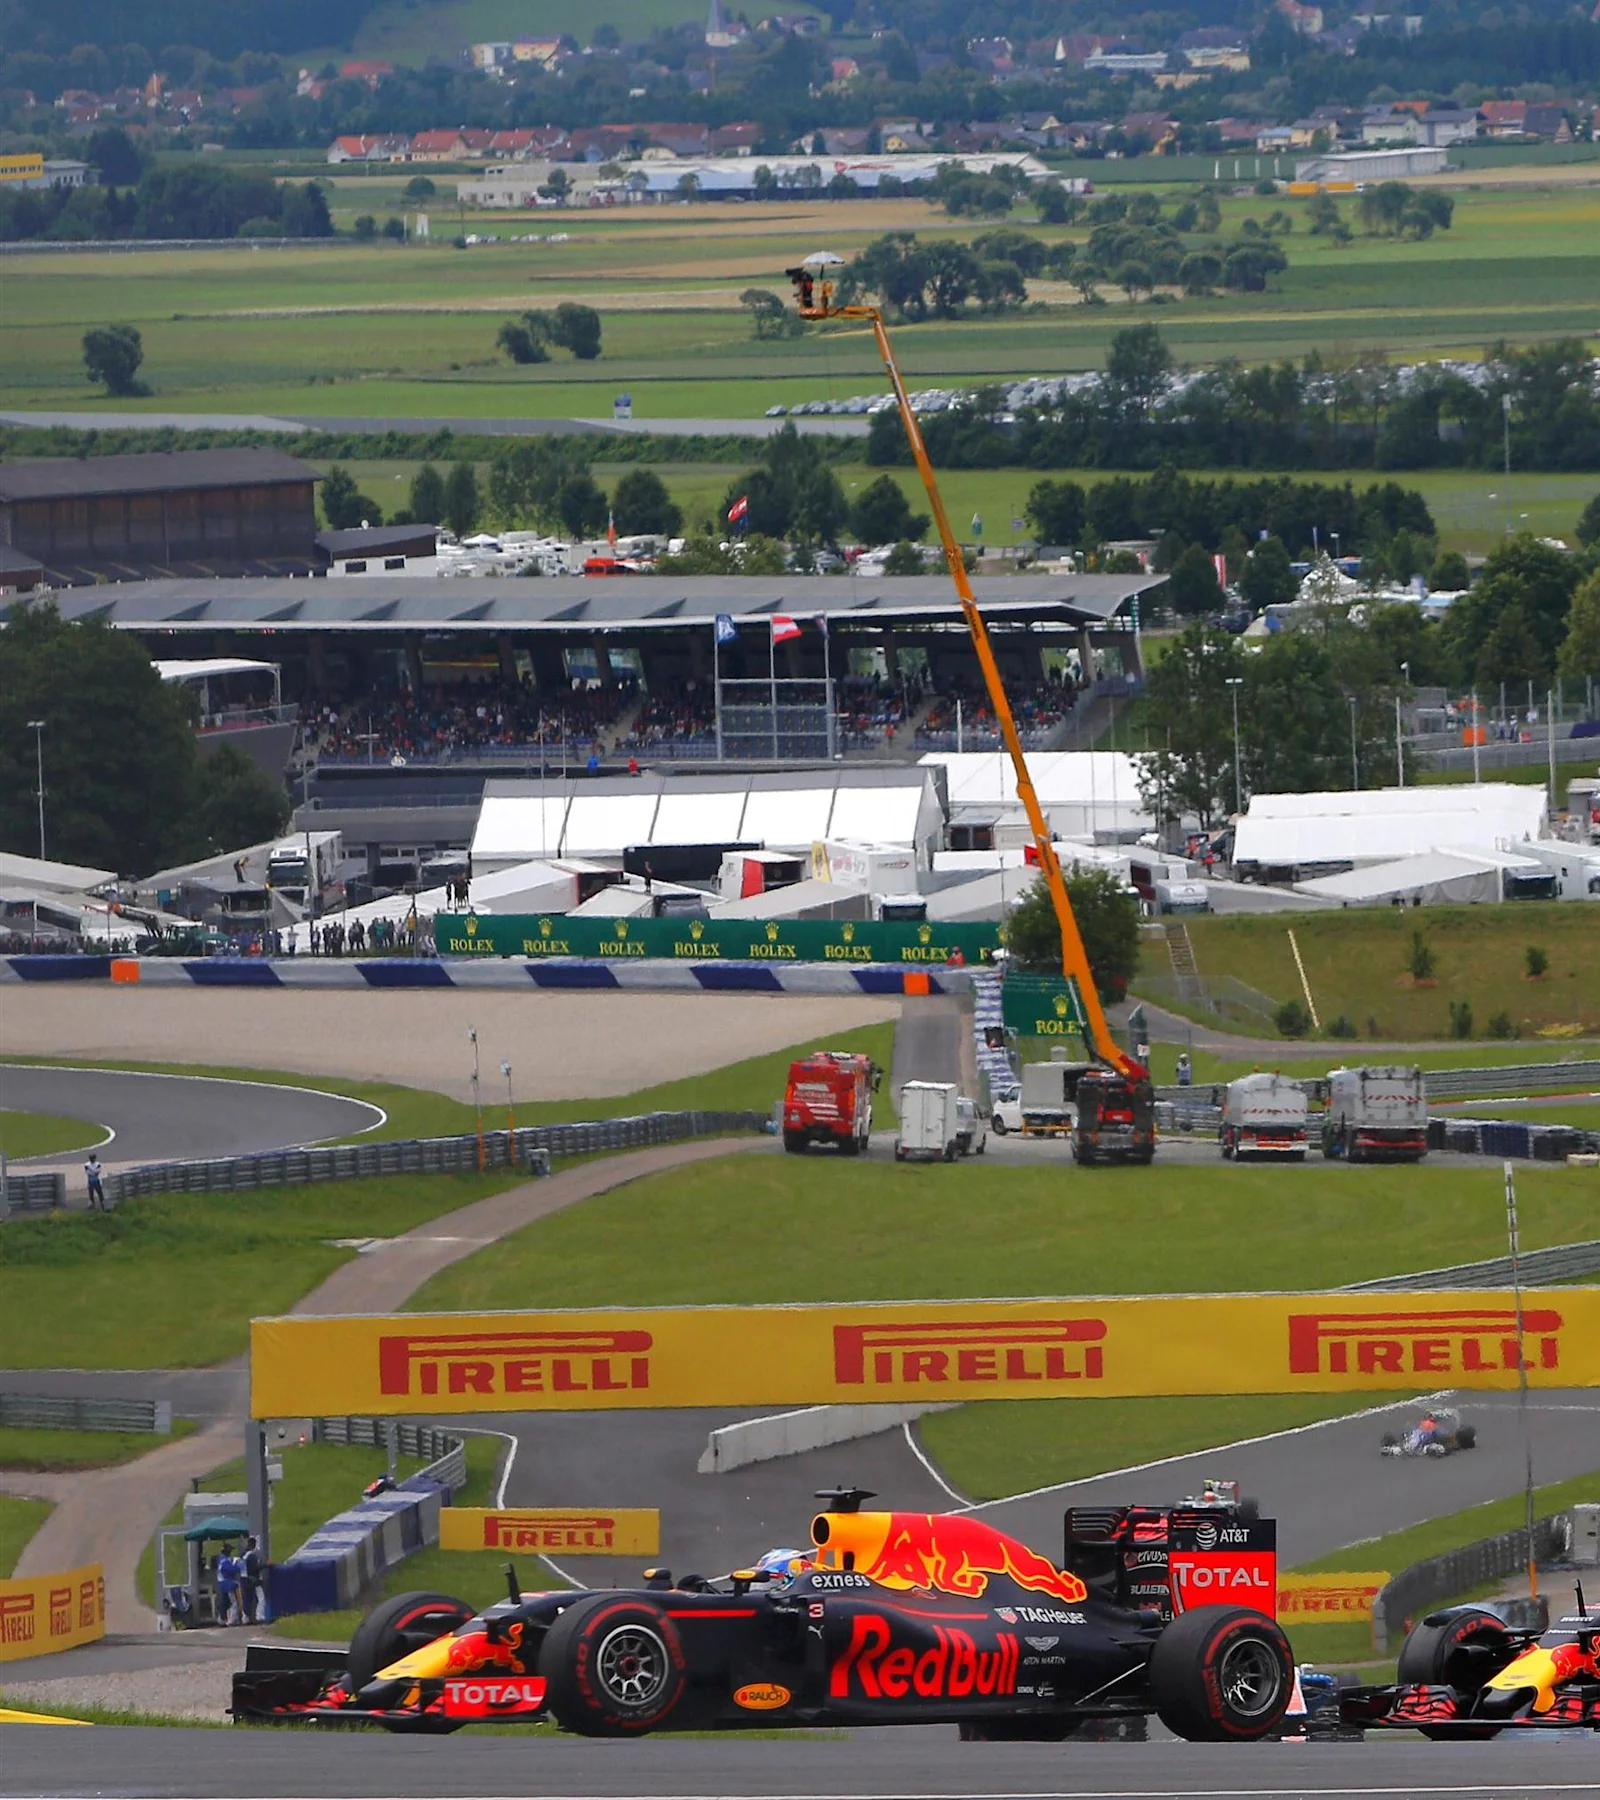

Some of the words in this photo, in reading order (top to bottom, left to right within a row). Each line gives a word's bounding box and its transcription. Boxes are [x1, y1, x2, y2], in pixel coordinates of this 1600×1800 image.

[450, 938, 494, 952] ROLEX
[523, 939, 569, 954] ROLEX
[600, 941, 645, 955] ROLEX
[674, 942, 719, 956] ROLEX
[750, 944, 796, 958] ROLEX
[825, 945, 872, 959] ROLEX
[902, 947, 948, 961] ROLEX
[379, 1331, 653, 1395] PIRELLI
[833, 1319, 1107, 1384] PIRELLI
[1289, 1310, 1563, 1373] PIRELLI
[484, 1517, 615, 1549] PIRELLI
[1220, 1529, 1249, 1543] AT&T
[811, 1574, 871, 1588] exness
[1173, 1562, 1269, 1588] TOTAL
[1279, 1587, 1379, 1612] PIRELL
[809, 1603, 825, 1618] 3
[445, 1682, 544, 1704] TOTAL
[748, 1690, 783, 1702] RAUCH
